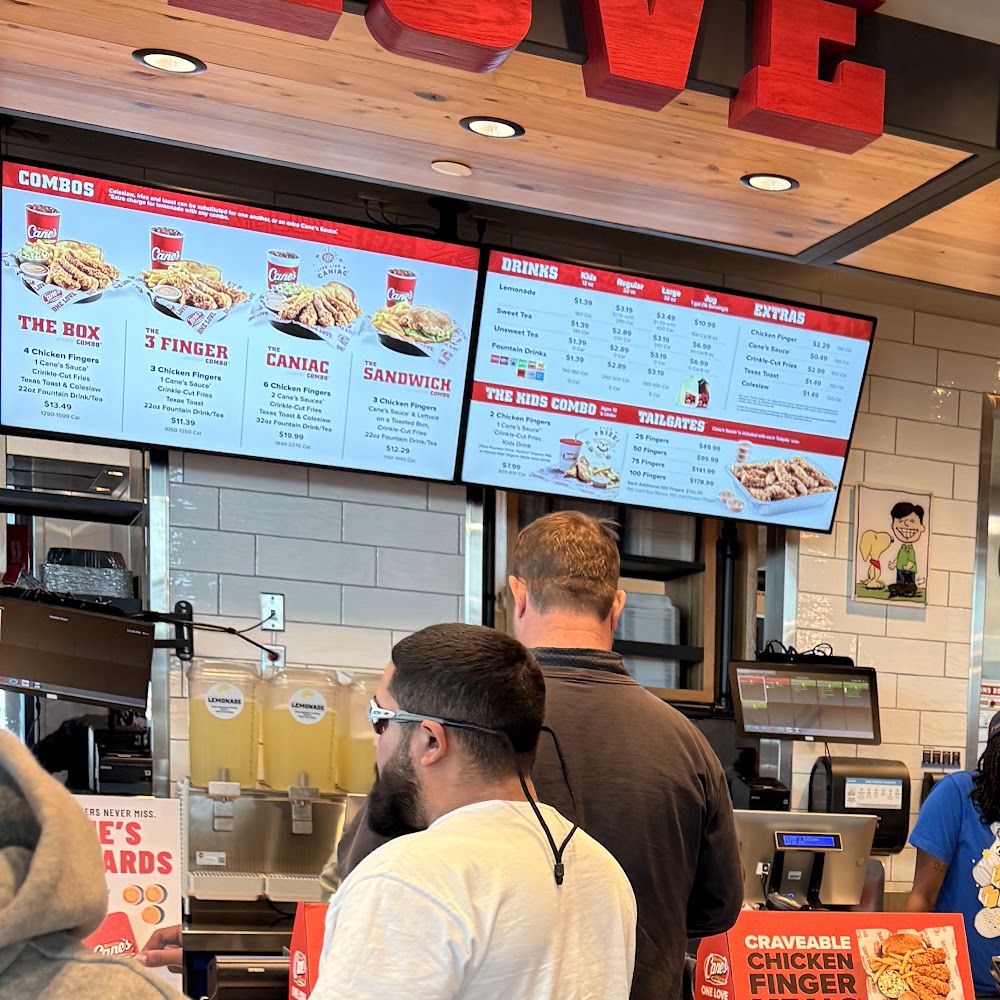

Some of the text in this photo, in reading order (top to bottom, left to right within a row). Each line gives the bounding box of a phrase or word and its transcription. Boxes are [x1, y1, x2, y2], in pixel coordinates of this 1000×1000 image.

[18, 170, 95, 198] COMBOS
[501, 256, 559, 280] DRINKS
[499, 283, 716, 328] Lemonade $1.39 $3.19 $3.49 $10.99
[754, 302, 806, 325] EXTRAS
[18, 315, 100, 340] THE BOX
[494, 324, 539, 338] Unsweet Tea
[76, 340, 100, 348] COMBO
[144, 334, 228, 360] 3 FINGER
[750, 328, 776, 339] Chicken
[777, 334, 797, 343] Finger
[812, 340, 830, 350] $2.29
[32, 348, 66, 359] Chicken
[68, 354, 100, 364] Fingers
[491, 342, 548, 358] Fountain Drinks
[40, 360, 64, 368] Cane's
[65, 363, 87, 372] Sauce
[205, 358, 228, 366] COMBO
[266, 352, 330, 374] CANIAC
[746, 354, 826, 374] Crinkle-Cut Fries $2.99
[32, 368, 90, 382] Crinkle-Cut Fries
[158, 366, 190, 377] Chicken
[192, 372, 222, 382] Fingers
[363, 367, 452, 392] SANDWICH
[744, 367, 822, 387] Texas Toast $1.49
[20, 376, 40, 384] Texas
[42, 378, 61, 388] Toast
[70, 382, 102, 392] Coleslaw
[158, 386, 195, 396] Crinkle-Cut
[270, 382, 301, 392] Chicken
[303, 387, 332, 397] Fingers
[741, 380, 820, 398] Coleslaw $1.49
[18, 386, 104, 402] 22oz Fountain Drink/Tea
[166, 396, 204, 406] Texas Toast
[485, 386, 514, 403] THE
[516, 391, 548, 408] KIDS
[550, 397, 597, 416] COMBO
[44, 400, 72, 410] $13.49
[380, 398, 409, 408] Chicken
[410, 402, 437, 412] Fingers
[171, 416, 196, 426] $11.39
[496, 412, 524, 422] Chicken
[526, 416, 551, 426] Fingers
[638, 410, 706, 433] TAILGATES
[278, 430, 304, 440] $19.99
[386, 445, 410, 454] $12.29
[291, 702, 325, 710] LEMONADE
[82, 808, 156, 818] ERS NEVER MISS.
[93, 820, 142, 846] E'S
[104, 850, 173, 875] ARDS
[744, 935, 852, 950] CRAVEABLE
[747, 952, 854, 970] CHICKEN
[701, 984, 713, 998] ONE
[750, 973, 858, 995] FINGER
